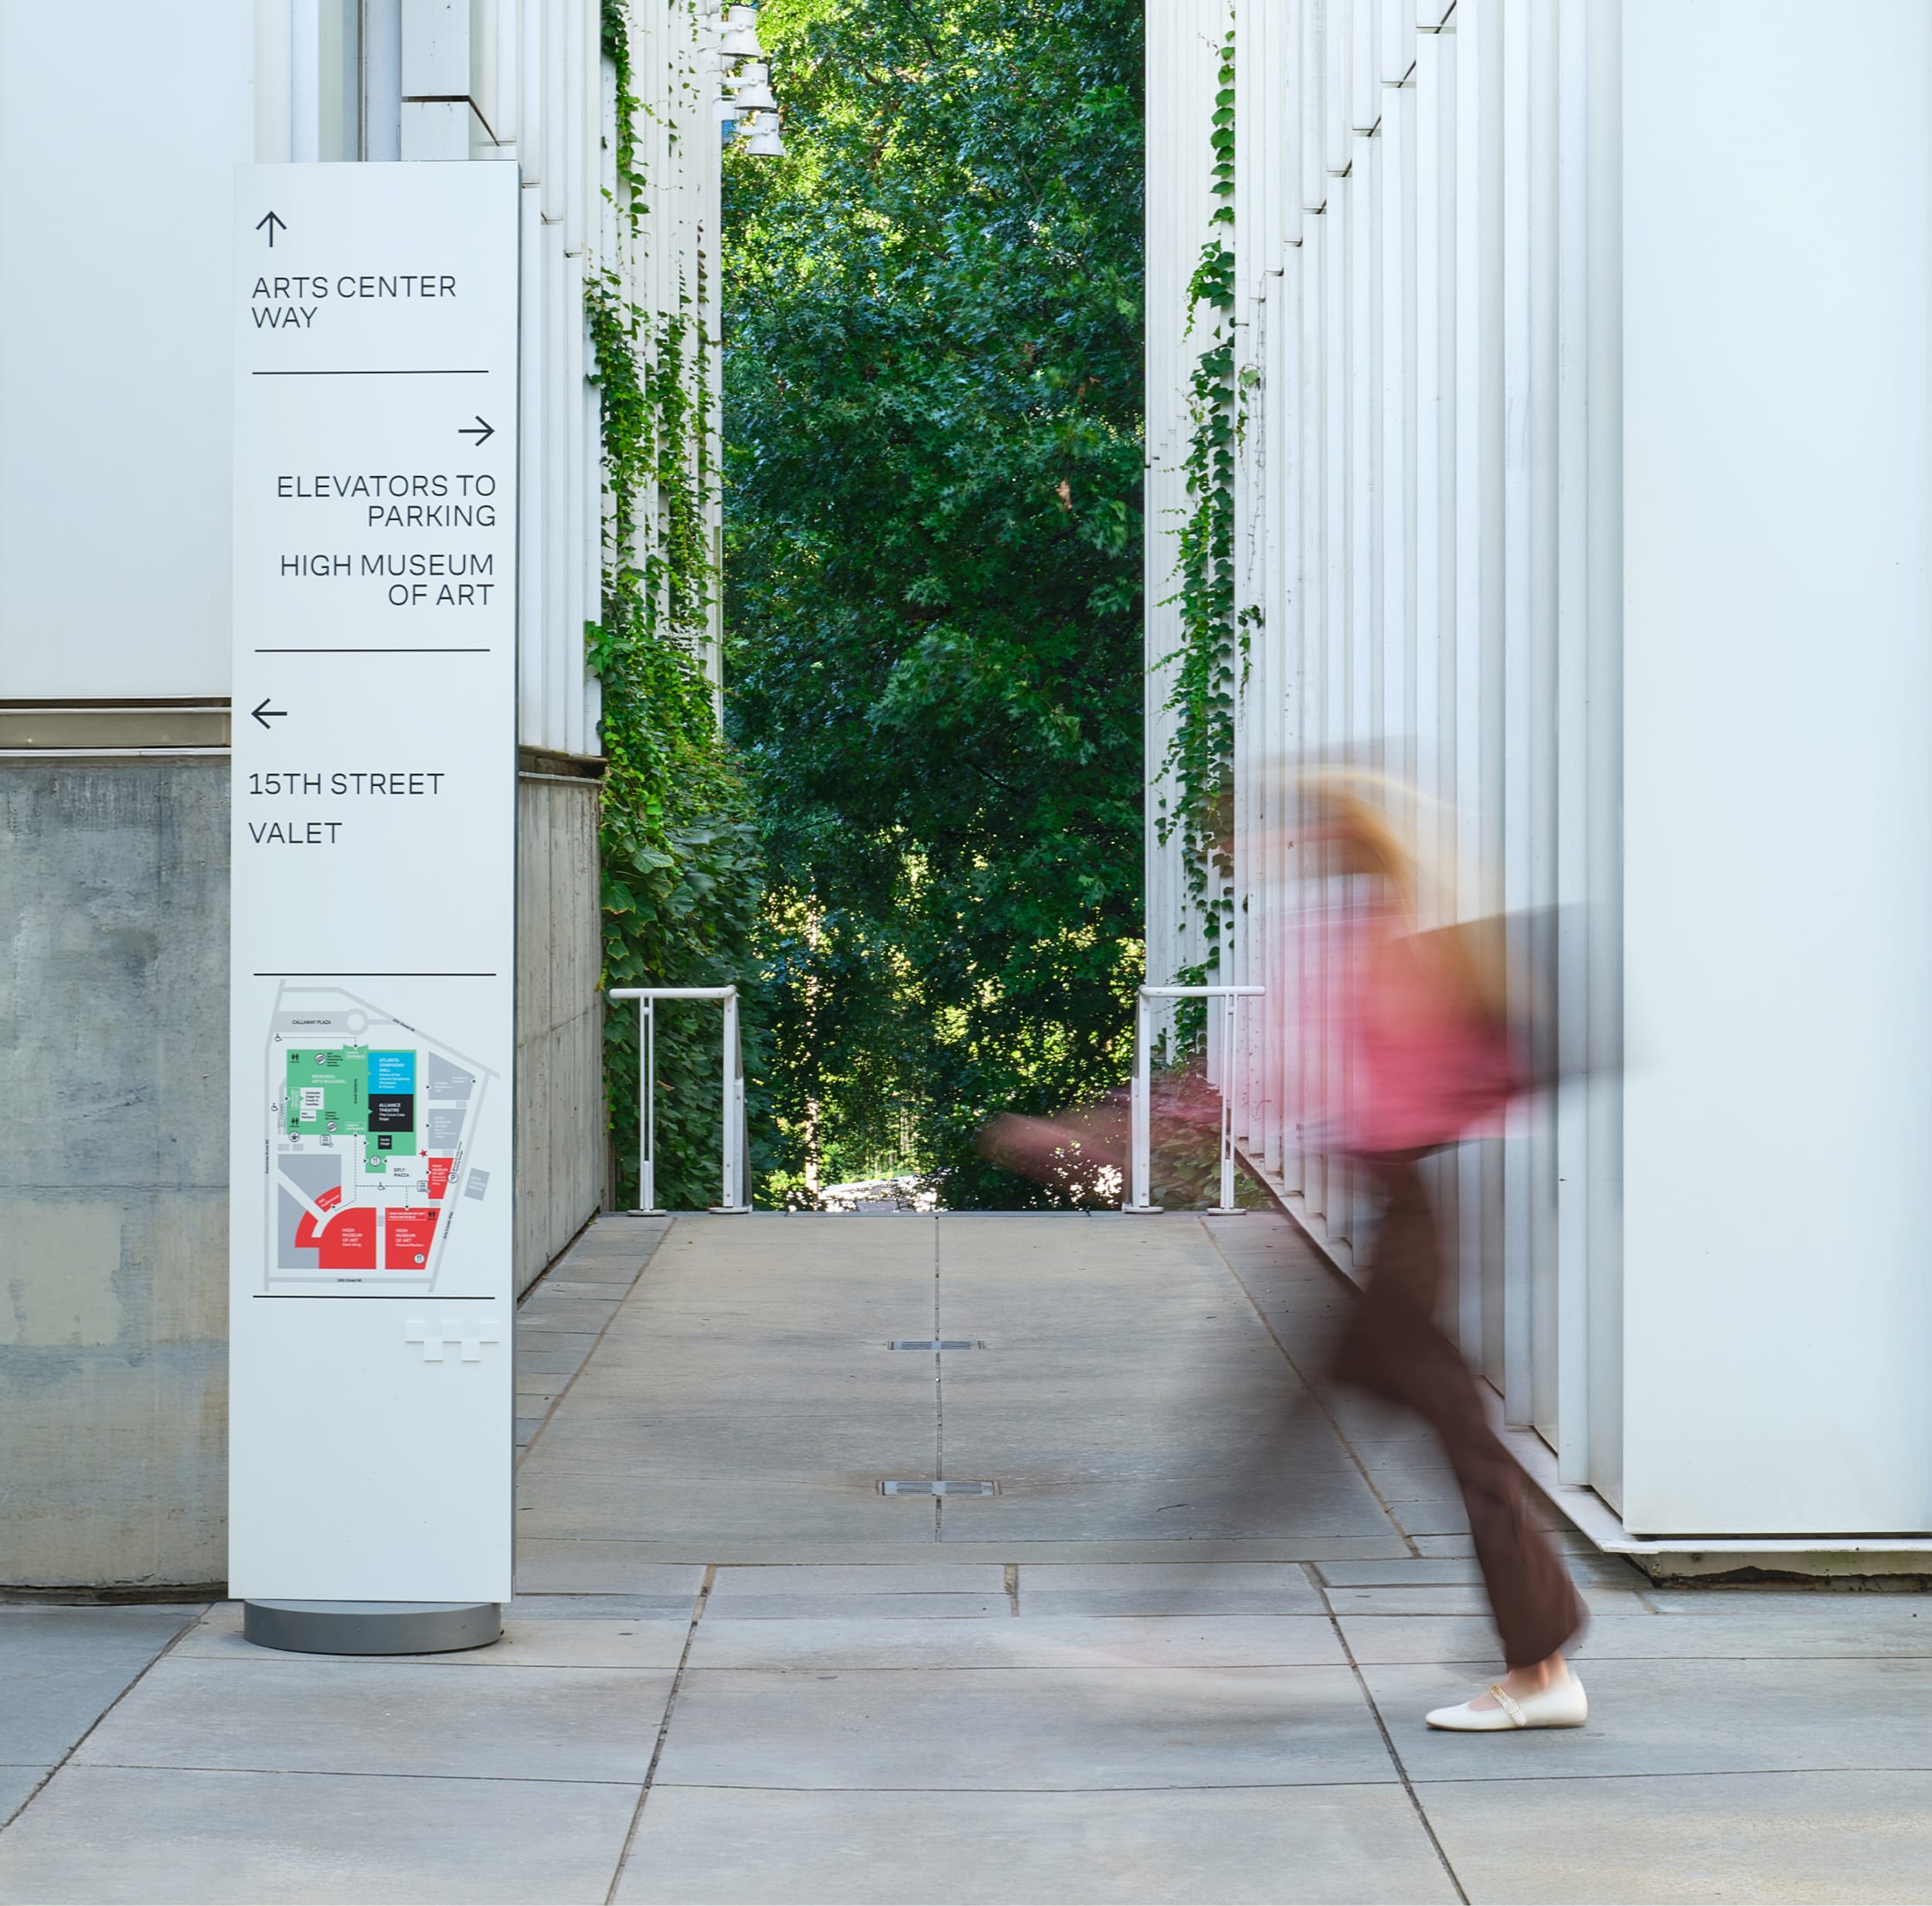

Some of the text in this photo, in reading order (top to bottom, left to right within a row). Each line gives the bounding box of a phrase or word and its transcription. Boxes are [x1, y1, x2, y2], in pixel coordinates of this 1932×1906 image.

[252, 276, 456, 299] ARTS CENTER
[252, 307, 318, 328] WAY
[277, 474, 495, 498] ELEVATORS TO
[369, 505, 495, 527] PARKING
[281, 554, 493, 576] HIGH MUSEUM
[389, 583, 495, 606] OF ART
[249, 773, 445, 795] 15TH STREET
[248, 822, 343, 844] VALET
